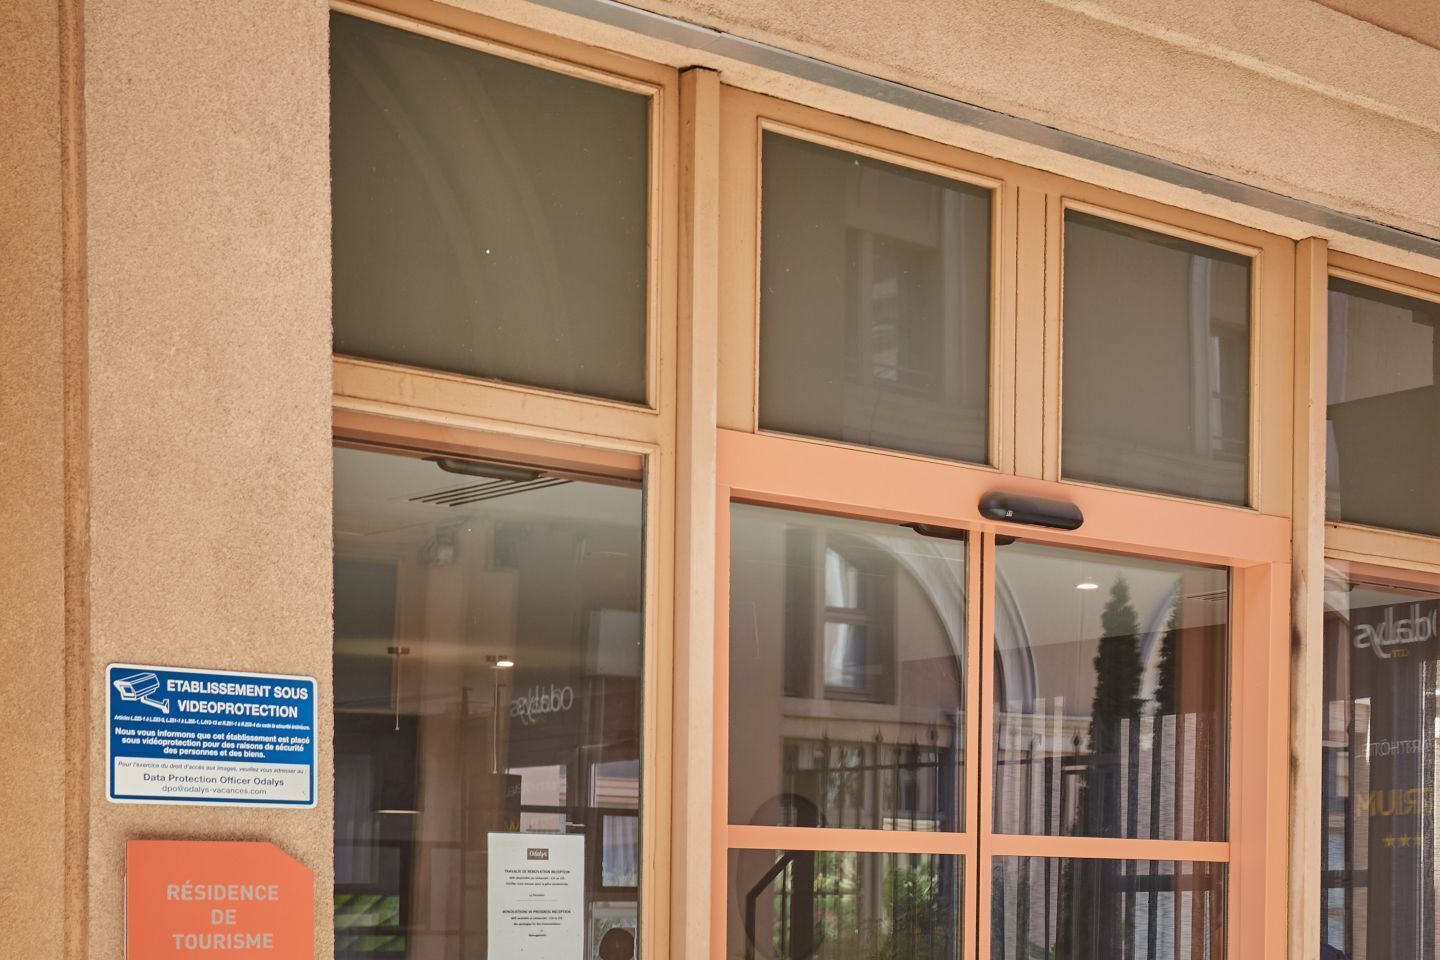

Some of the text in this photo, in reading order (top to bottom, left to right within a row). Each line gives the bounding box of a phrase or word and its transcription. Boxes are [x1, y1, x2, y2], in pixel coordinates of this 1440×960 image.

[166, 679, 308, 700] ETABLISSEMENT SOUS
[177, 699, 298, 718] VIDEOPROTECTION
[115, 727, 135, 736] Nous
[137, 729, 156, 737] vous
[157, 729, 196, 739] informons
[196, 732, 211, 741] que
[225, 732, 277, 742] établissement
[290, 736, 310, 745] placé
[142, 737, 201, 747] vidéoprotection
[202, 741, 220, 749] pour
[236, 742, 263, 750] raisons
[264, 742, 274, 750] de
[275, 743, 304, 752] sécurité
[163, 746, 266, 758] des personnes et des biens.
[118, 760, 132, 768] Pour
[143, 772, 284, 787] Data Protection Officer Odalys
[161, 785, 267, 795] dpo@odalys-vacances.com
[166, 879, 280, 901] RÉSIDENCE
[210, 908, 237, 926] DE
[171, 932, 275, 951] TOURISME
